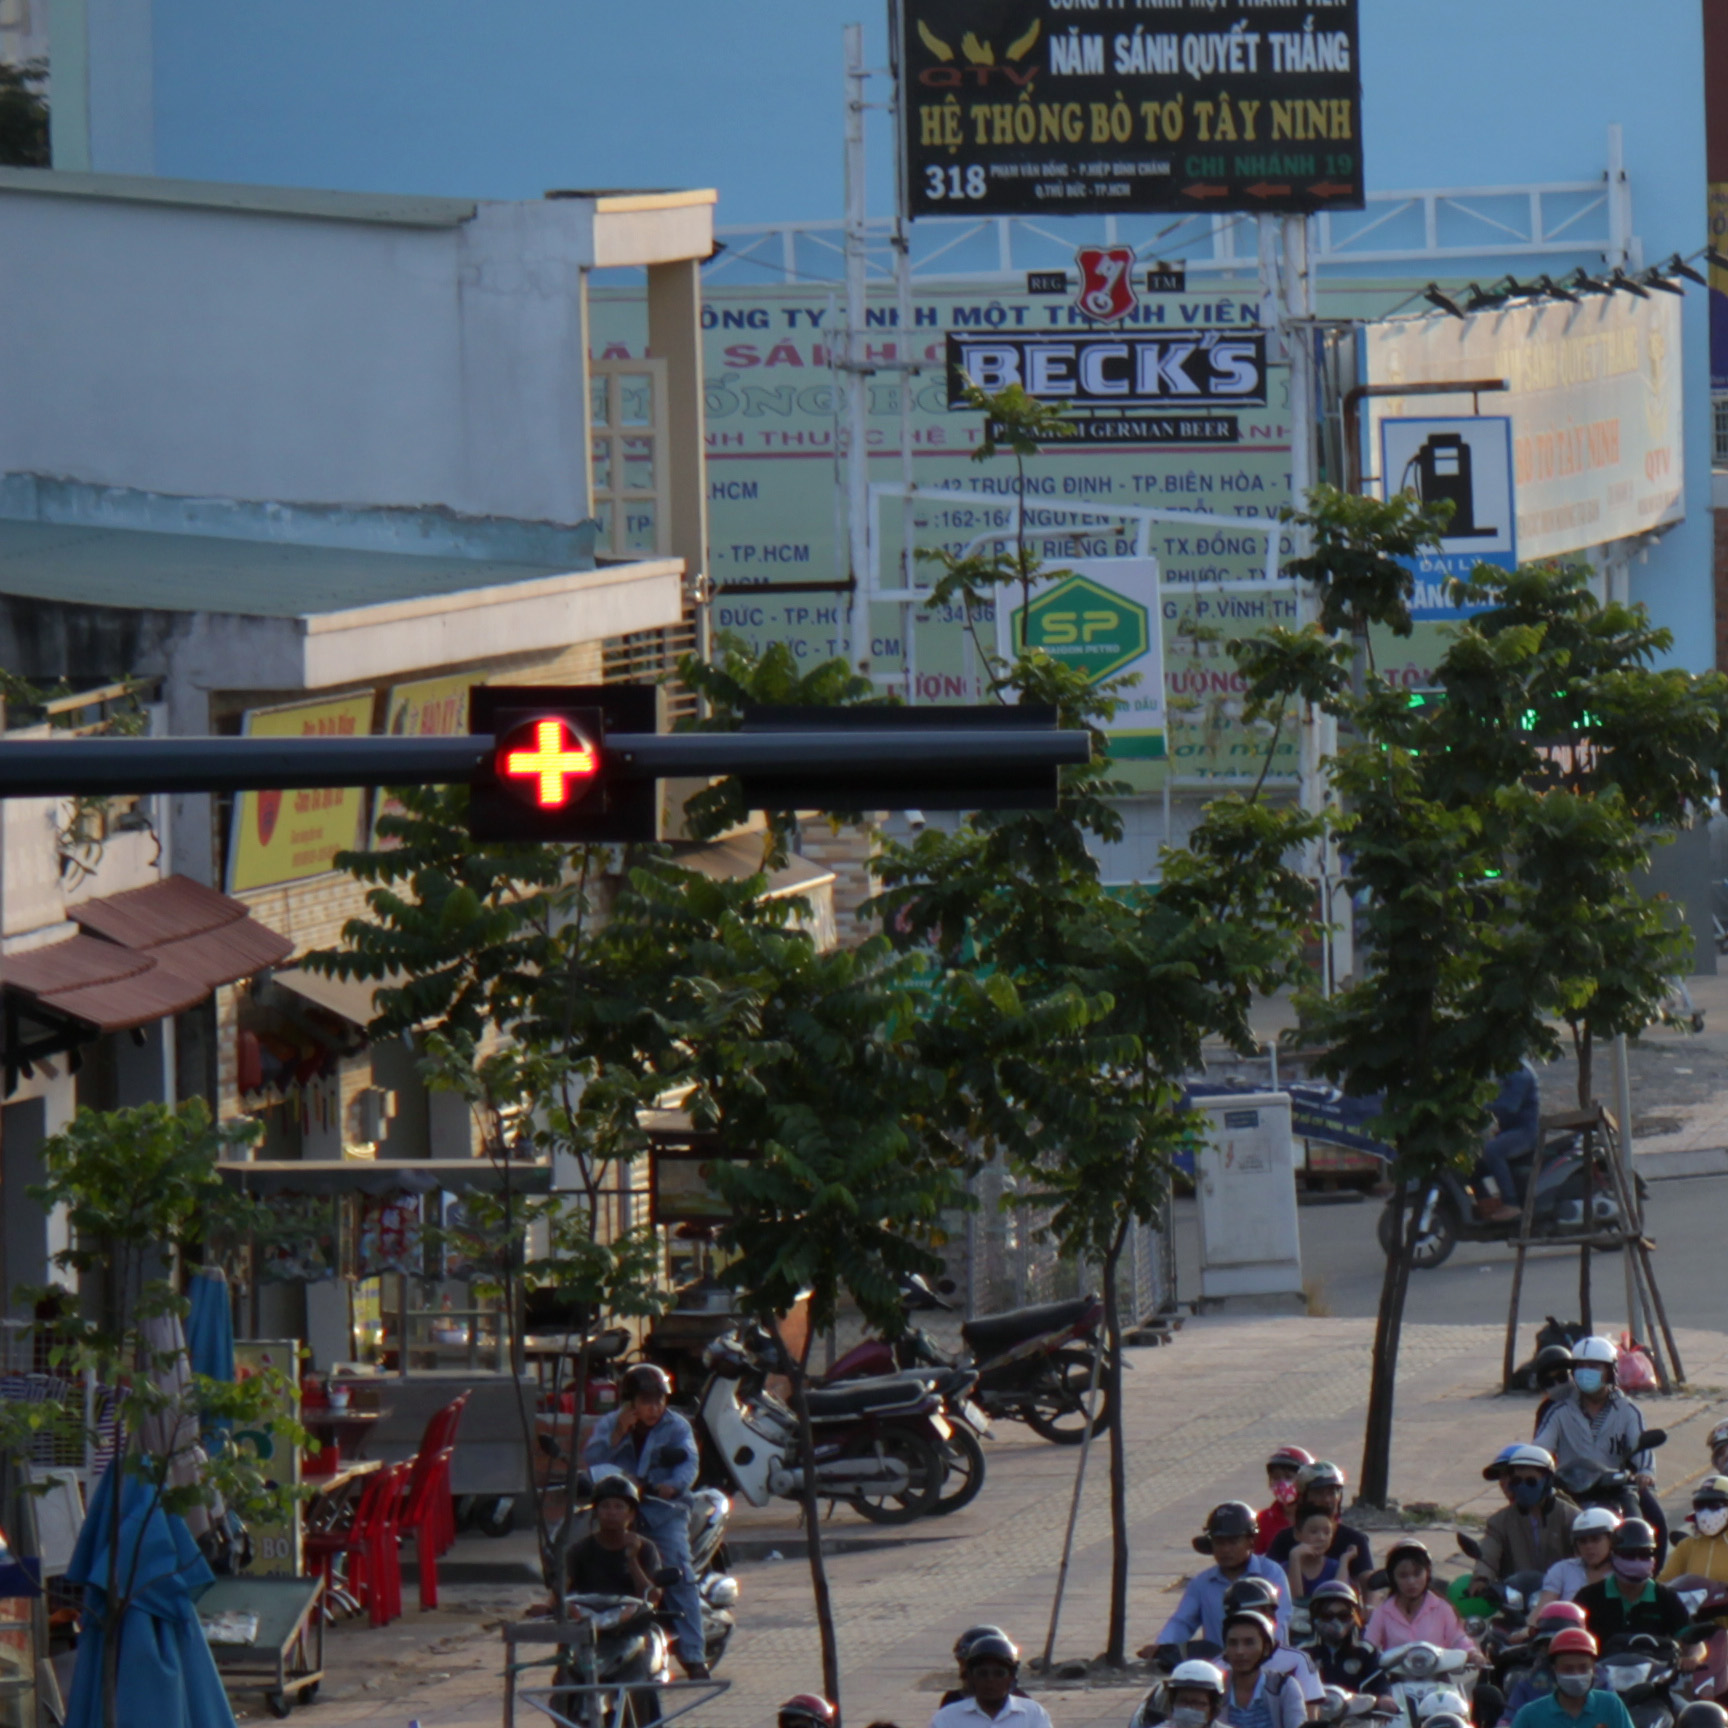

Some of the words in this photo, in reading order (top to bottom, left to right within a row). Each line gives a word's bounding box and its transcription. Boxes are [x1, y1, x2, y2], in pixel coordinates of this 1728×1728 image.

[1050, 25, 1104, 75] NĂM
[1114, 23, 1179, 75] SÁNH
[1181, 18, 1261, 80] QUYẾT
[1268, 14, 1350, 73] THẮNG
[919, 66, 1040, 87] QTV
[919, 93, 963, 154] HỆ
[970, 82, 1084, 145] THỐNG
[1089, 90, 1133, 143] BÒ
[1140, 92, 1184, 142] TƠ
[1193, 90, 1261, 141] TÂY
[1270, 99, 1352, 140] NINH
[1325, 154, 1353, 176] 19
[925, 164, 987, 199] 318
[700, 304, 770, 330] ÔNG
[779, 308, 828, 329] TY
[952, 300, 1030, 330] MỘT
[1043, 303, 1165, 325] THNH
[960, 332, 1259, 396] BECK'S
[1090, 417, 1176, 437] GERMAN
[1180, 415, 1230, 437] BEER
[731, 544, 810, 562] TP.HCM
[1042, 611, 1119, 644] SP
[1165, 667, 1250, 695] ƯỢNG
